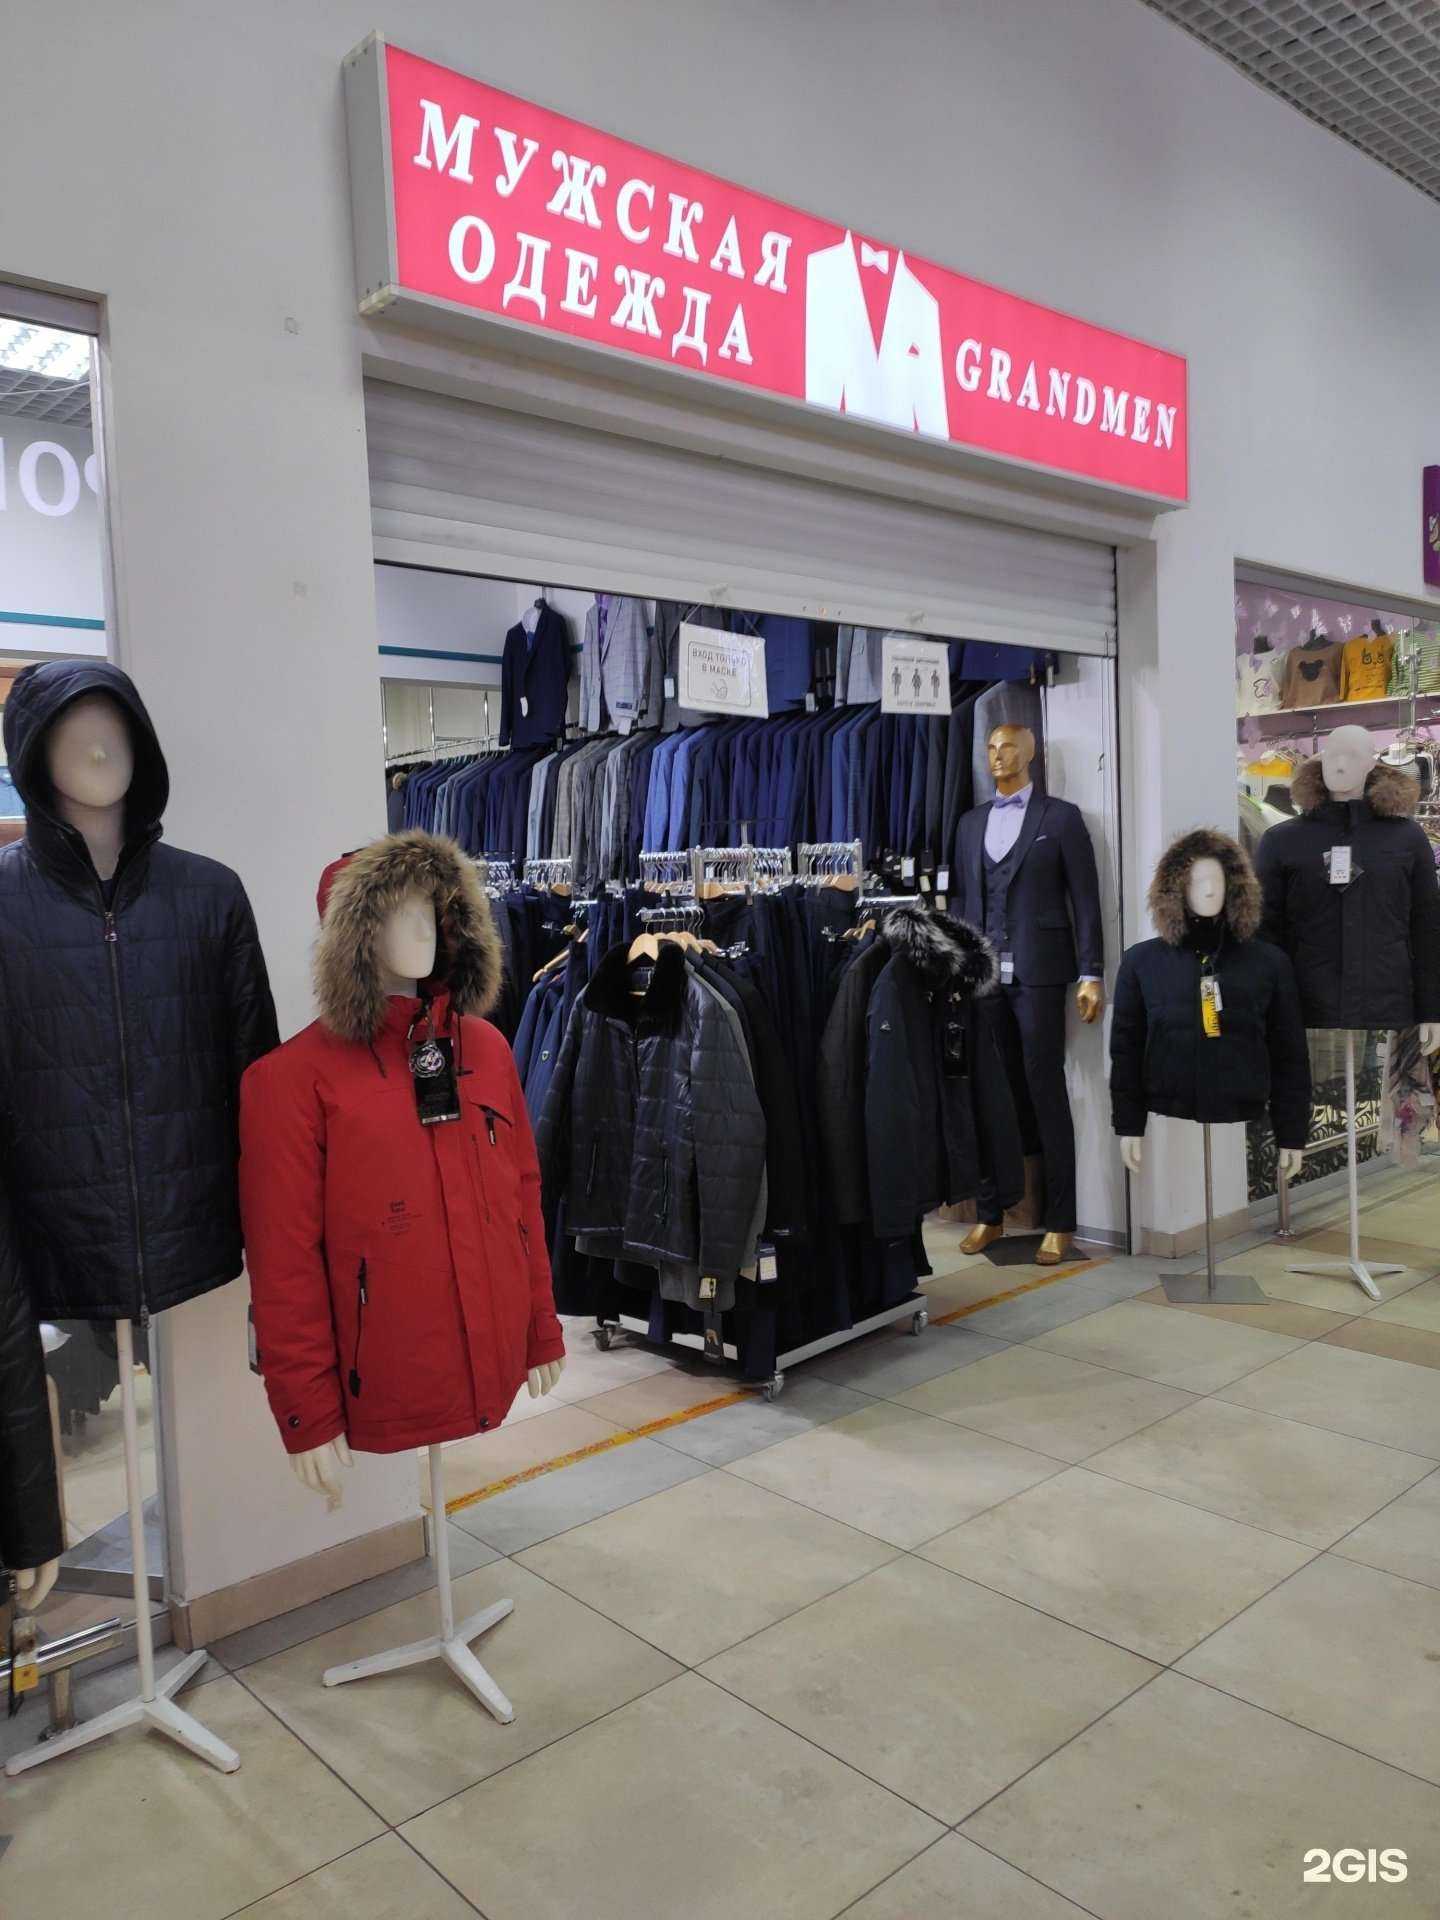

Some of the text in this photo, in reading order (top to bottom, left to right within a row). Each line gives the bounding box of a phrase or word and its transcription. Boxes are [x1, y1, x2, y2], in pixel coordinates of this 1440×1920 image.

[412, 98, 793, 294] МУЖСКАЯ
[447, 214, 754, 366] ОДЕЖДА
[954, 338, 1178, 450] GRANDMEN
[692, 647, 713, 661] ВХОД
